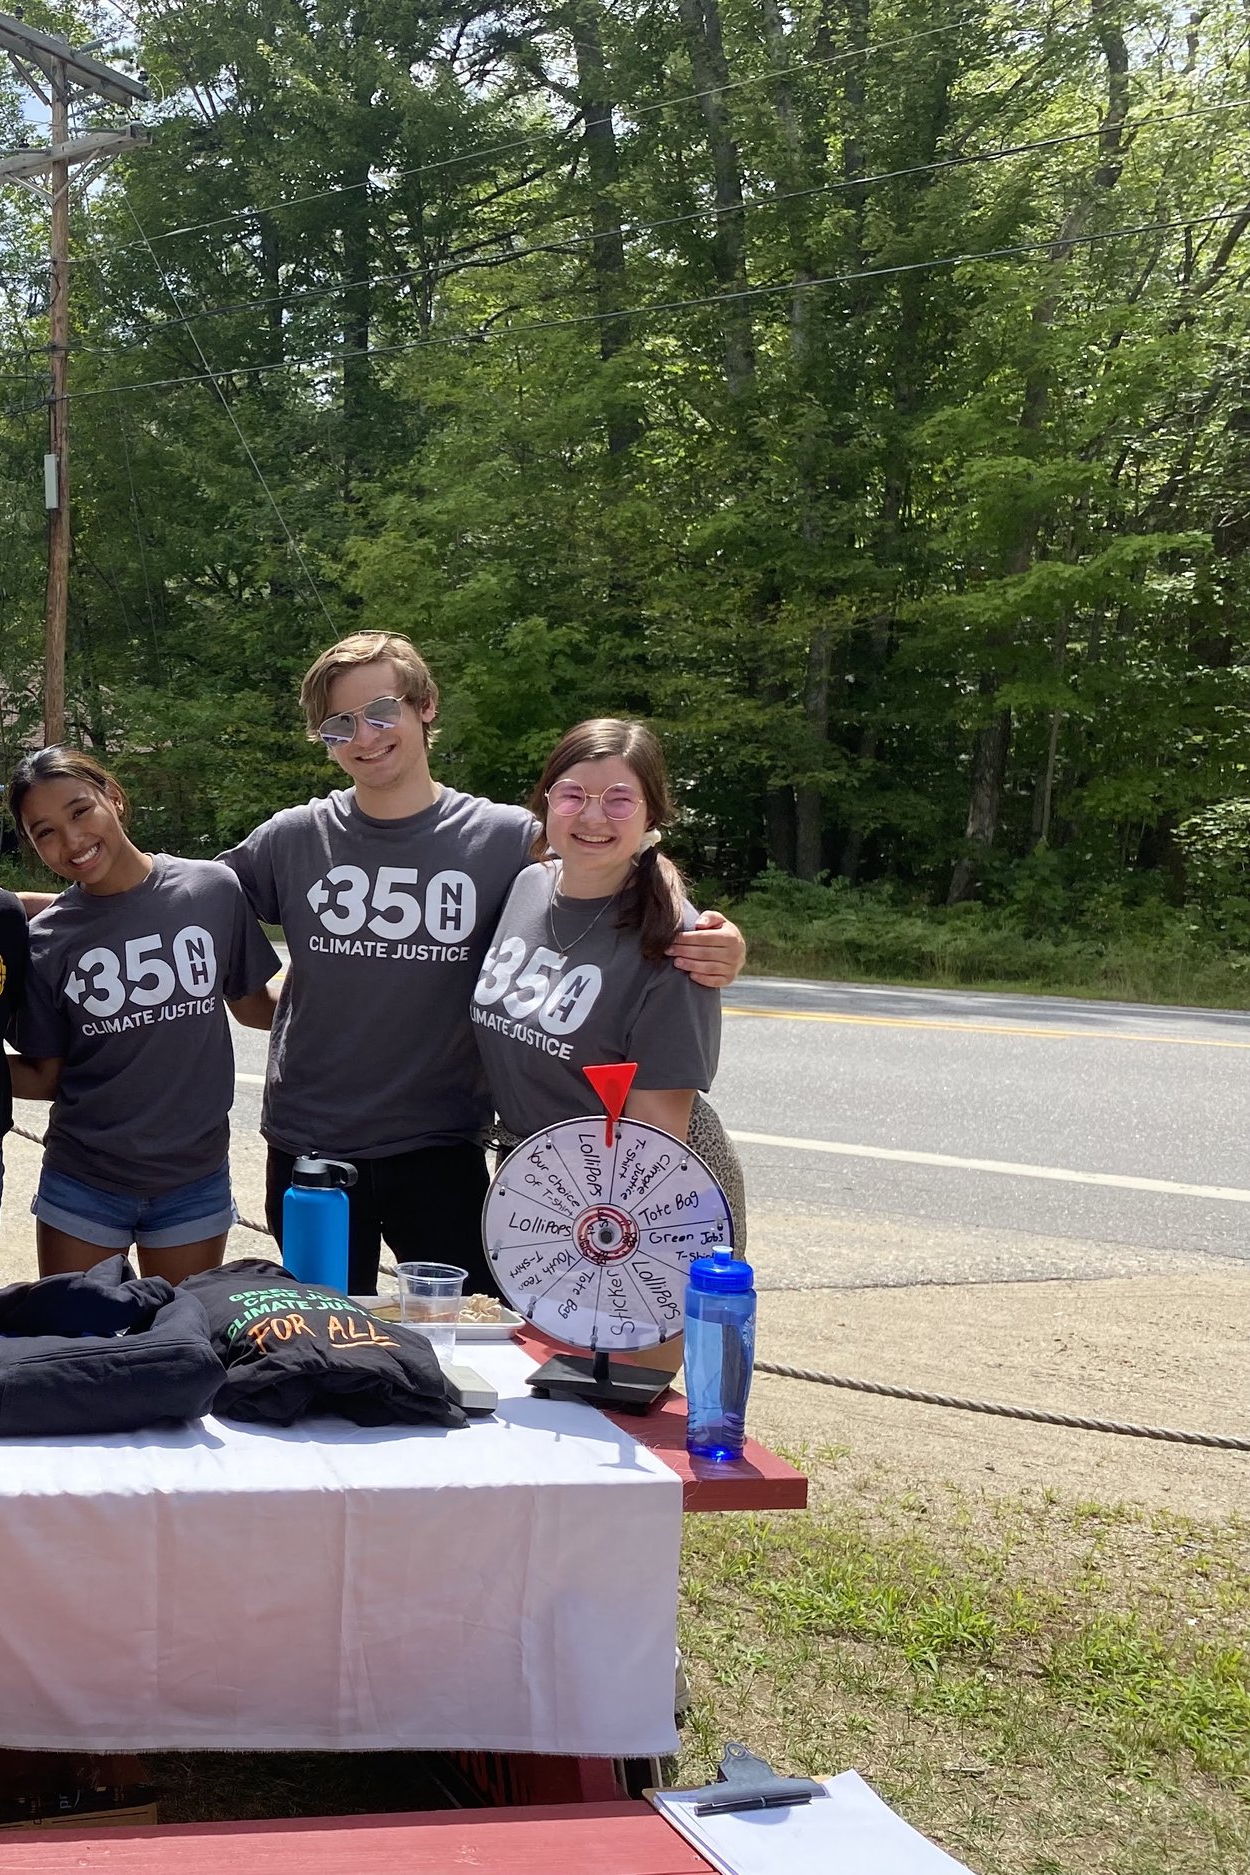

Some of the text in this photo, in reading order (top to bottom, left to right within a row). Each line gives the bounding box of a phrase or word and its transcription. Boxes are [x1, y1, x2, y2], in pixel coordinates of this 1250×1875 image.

[309, 935, 470, 962] CLIMATE JUSTICE
[82, 996, 216, 1037] CLIMATE JUSTICE
[469, 1004, 574, 1061] LIMATE JUSTICE
[527, 1145, 550, 1171] Your
[638, 1190, 699, 1226] Tote Bag
[557, 1271, 595, 1320] Tote Bag
[227, 1300, 313, 1341] CLIMATE
[248, 1313, 390, 1355] FOR ALL
